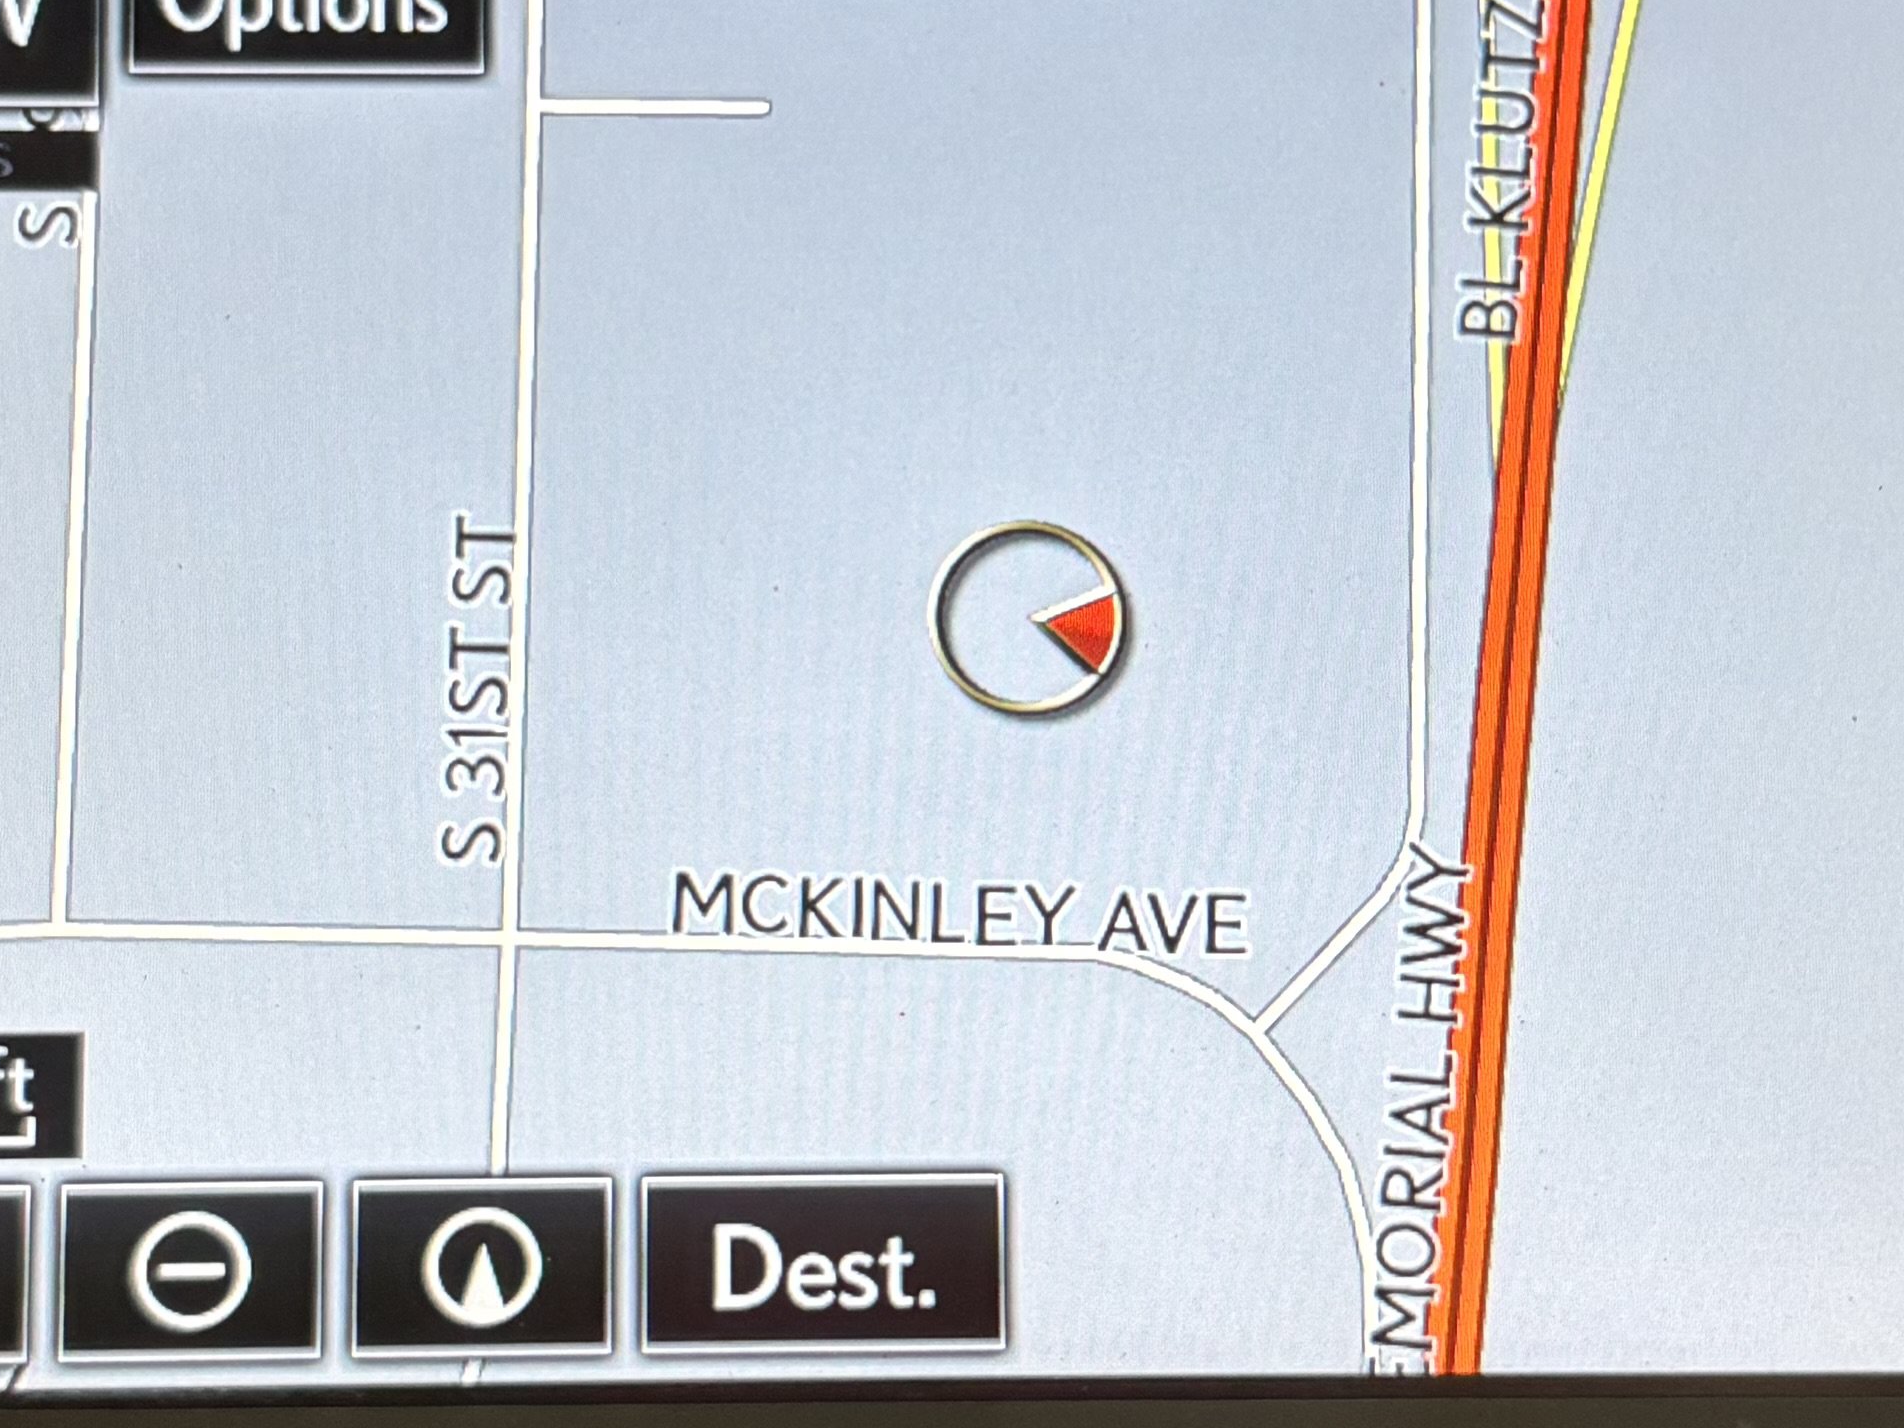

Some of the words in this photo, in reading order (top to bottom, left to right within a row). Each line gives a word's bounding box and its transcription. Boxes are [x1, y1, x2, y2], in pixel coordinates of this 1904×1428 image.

[18, 206, 78, 241] S
[1459, 258, 1523, 338] BL
[452, 513, 517, 605] ST
[445, 626, 511, 797] 31ST
[441, 822, 503, 863] S
[672, 871, 1078, 948] MCKINLEY
[1097, 891, 1248, 955] AVE
[1396, 841, 1470, 1022] HWY
[712, 1221, 938, 1311] Dest.
